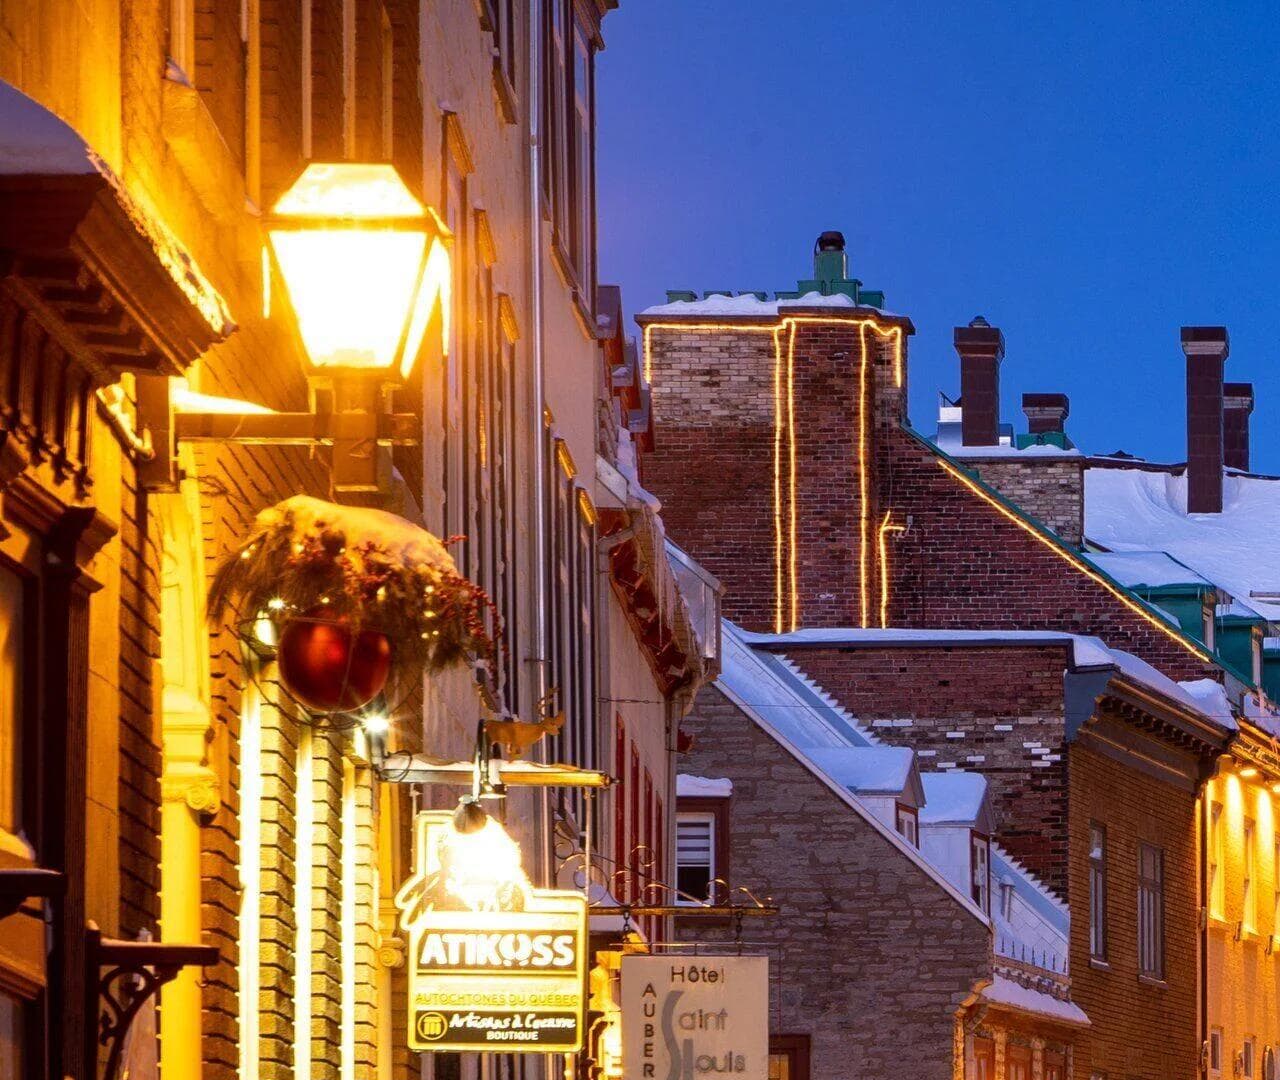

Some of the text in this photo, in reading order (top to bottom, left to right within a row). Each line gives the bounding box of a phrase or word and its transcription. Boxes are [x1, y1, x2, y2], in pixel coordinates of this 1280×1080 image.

[671, 965, 725, 983] Hôtel
[416, 993, 506, 1006] AUTOCHTONES
[486, 1031, 539, 1041] BOUTIQUE
